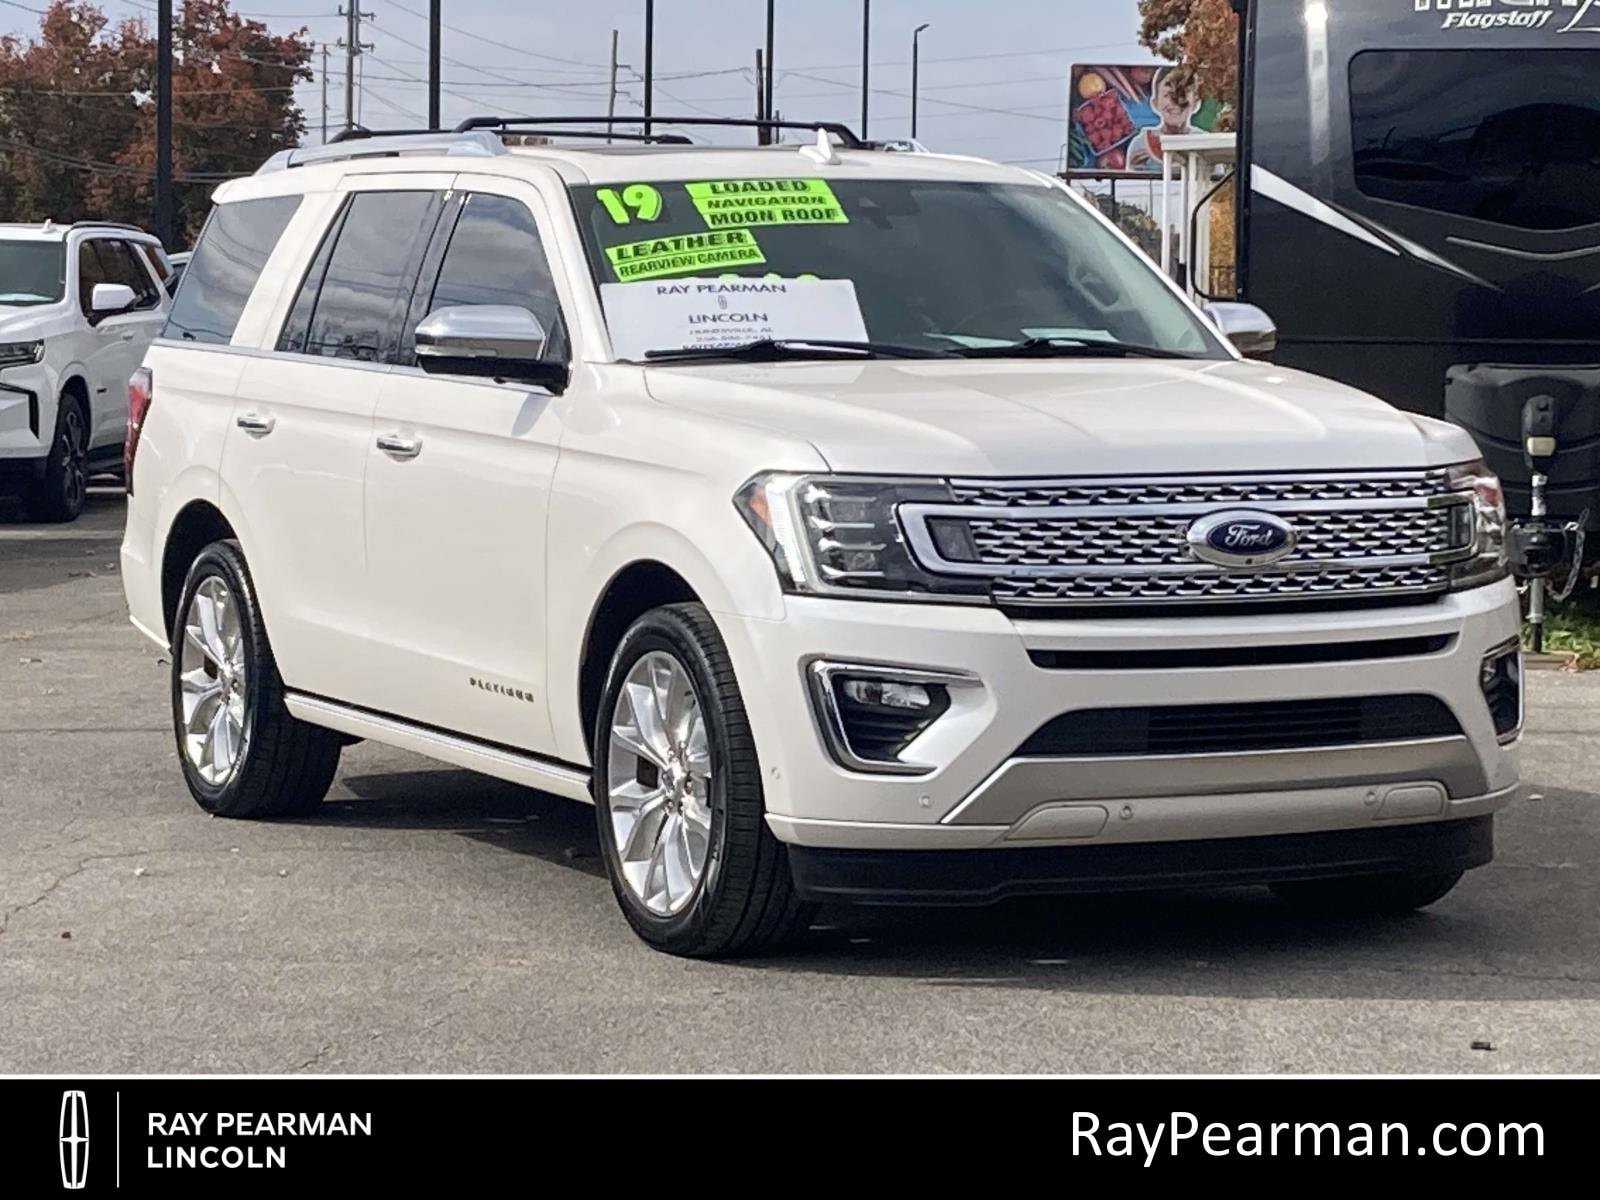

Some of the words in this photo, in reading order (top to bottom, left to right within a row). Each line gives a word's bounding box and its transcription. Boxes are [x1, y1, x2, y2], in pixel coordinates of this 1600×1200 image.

[1440, 10, 1553, 30] Flagstaff
[710, 180, 811, 195] LOADED
[596, 184, 662, 224] 19
[707, 195, 827, 209] NAVIGATION
[709, 209, 775, 226] MOON
[781, 207, 839, 222] ROOF
[616, 231, 745, 261] LEATHER
[618, 255, 697, 277] REARVIEW
[697, 249, 761, 264] CAMERA
[656, 284, 691, 295] RAY
[697, 284, 787, 294] PEARMAN
[688, 312, 769, 324] LINCOLN
[1224, 523, 1274, 546] Ford
